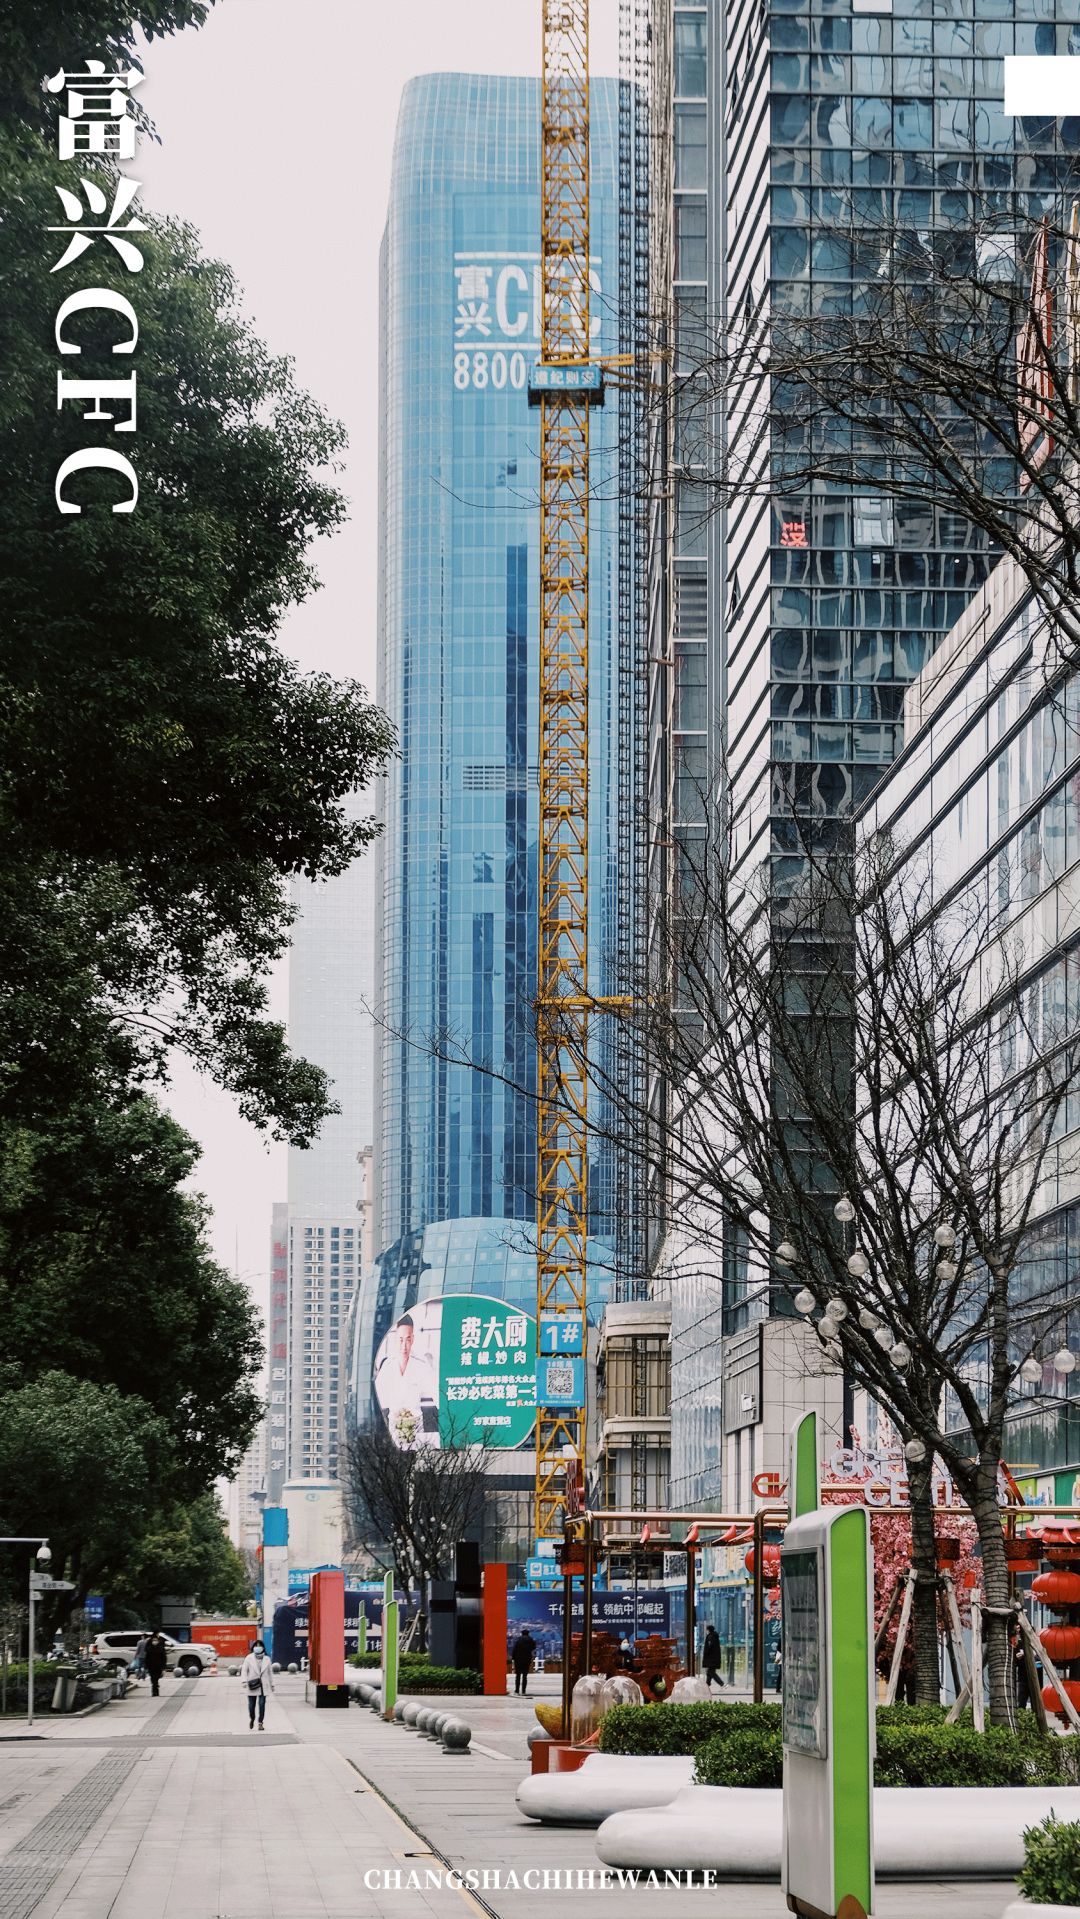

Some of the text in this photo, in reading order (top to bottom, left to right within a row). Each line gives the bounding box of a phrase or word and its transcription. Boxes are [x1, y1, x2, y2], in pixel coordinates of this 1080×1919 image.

[461, 1315, 527, 1349] 费大厨
[546, 1323, 579, 1350] 1#
[460, 1350, 527, 1366] 辣椒炒肉
